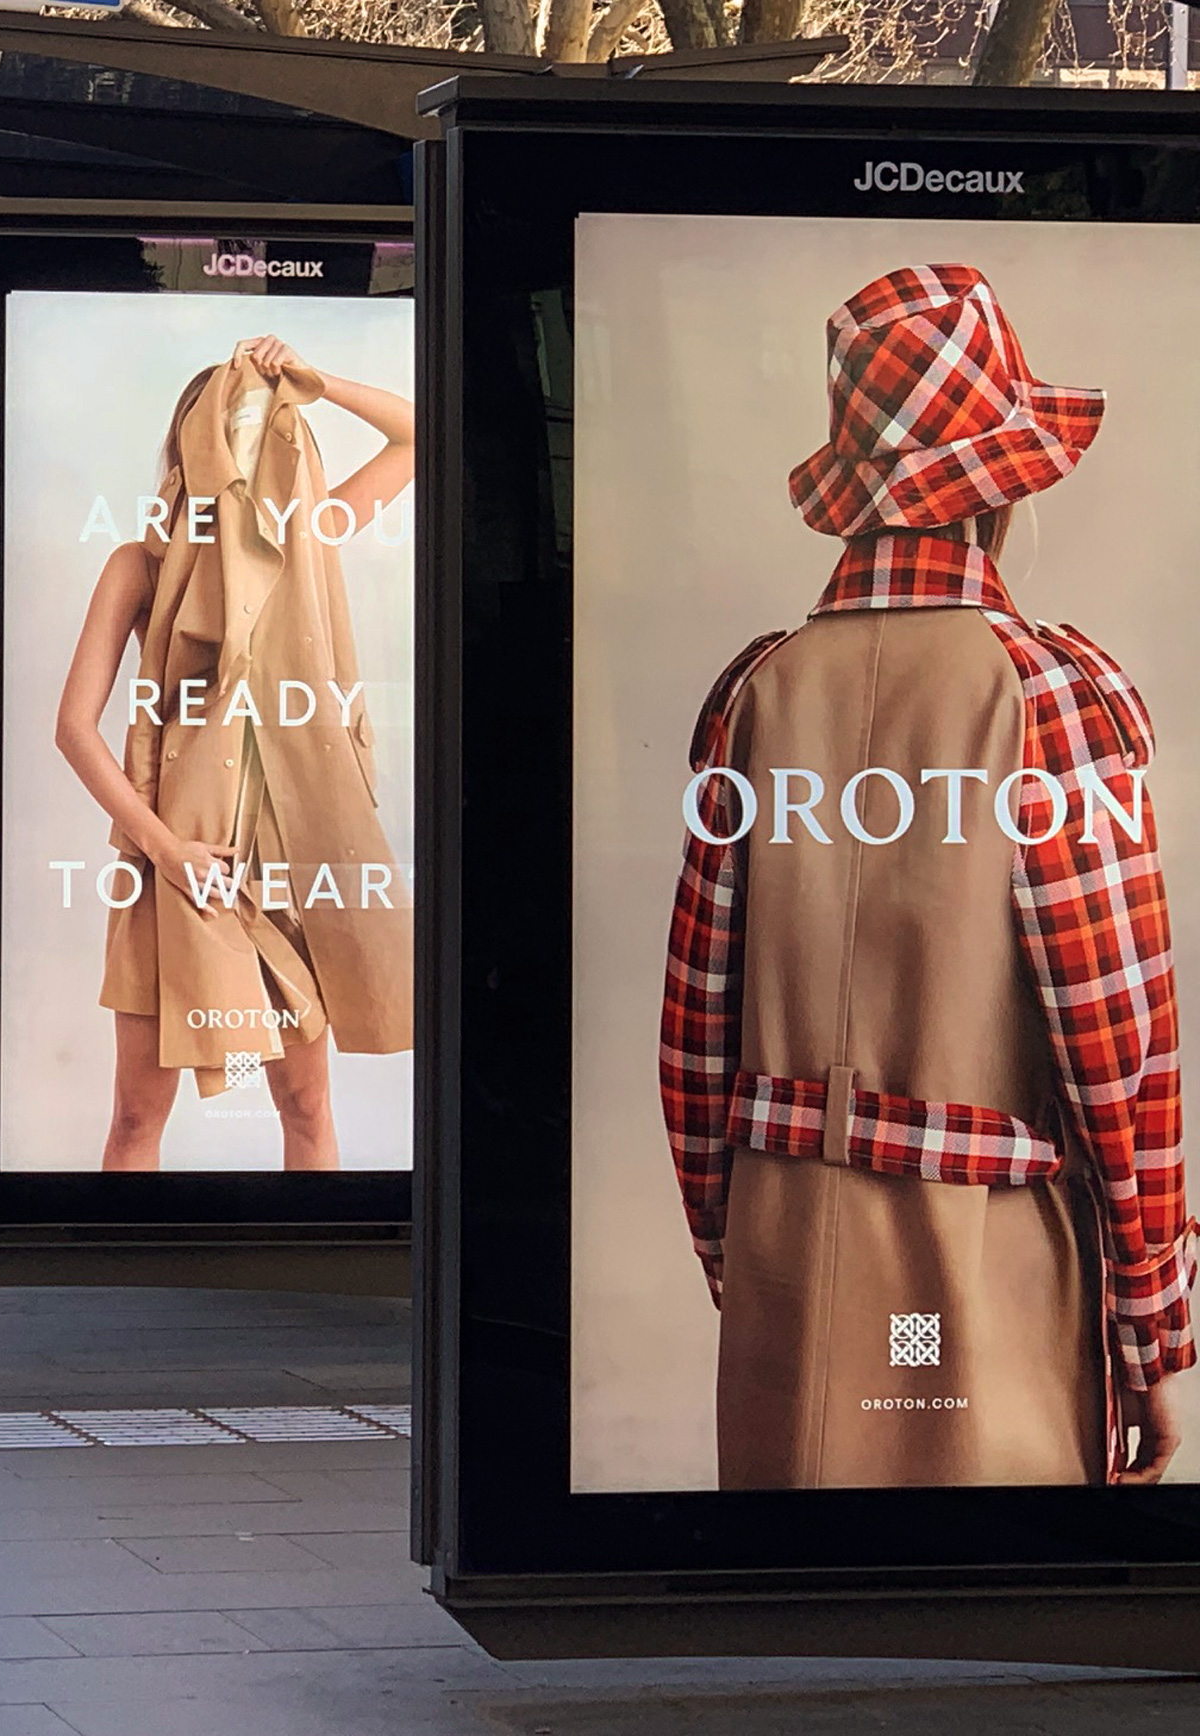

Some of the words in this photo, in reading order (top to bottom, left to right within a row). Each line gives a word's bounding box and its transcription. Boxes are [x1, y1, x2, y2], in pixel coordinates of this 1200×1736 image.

[853, 161, 1024, 194] JCDecaux
[203, 253, 324, 279] JCDecaux
[78, 495, 216, 544] ARE
[128, 679, 365, 727] READY
[681, 766, 1148, 847] OROTON
[49, 861, 144, 909] TO
[186, 1008, 301, 1030] OROTON
[861, 1397, 969, 1411] OROTON.COM
